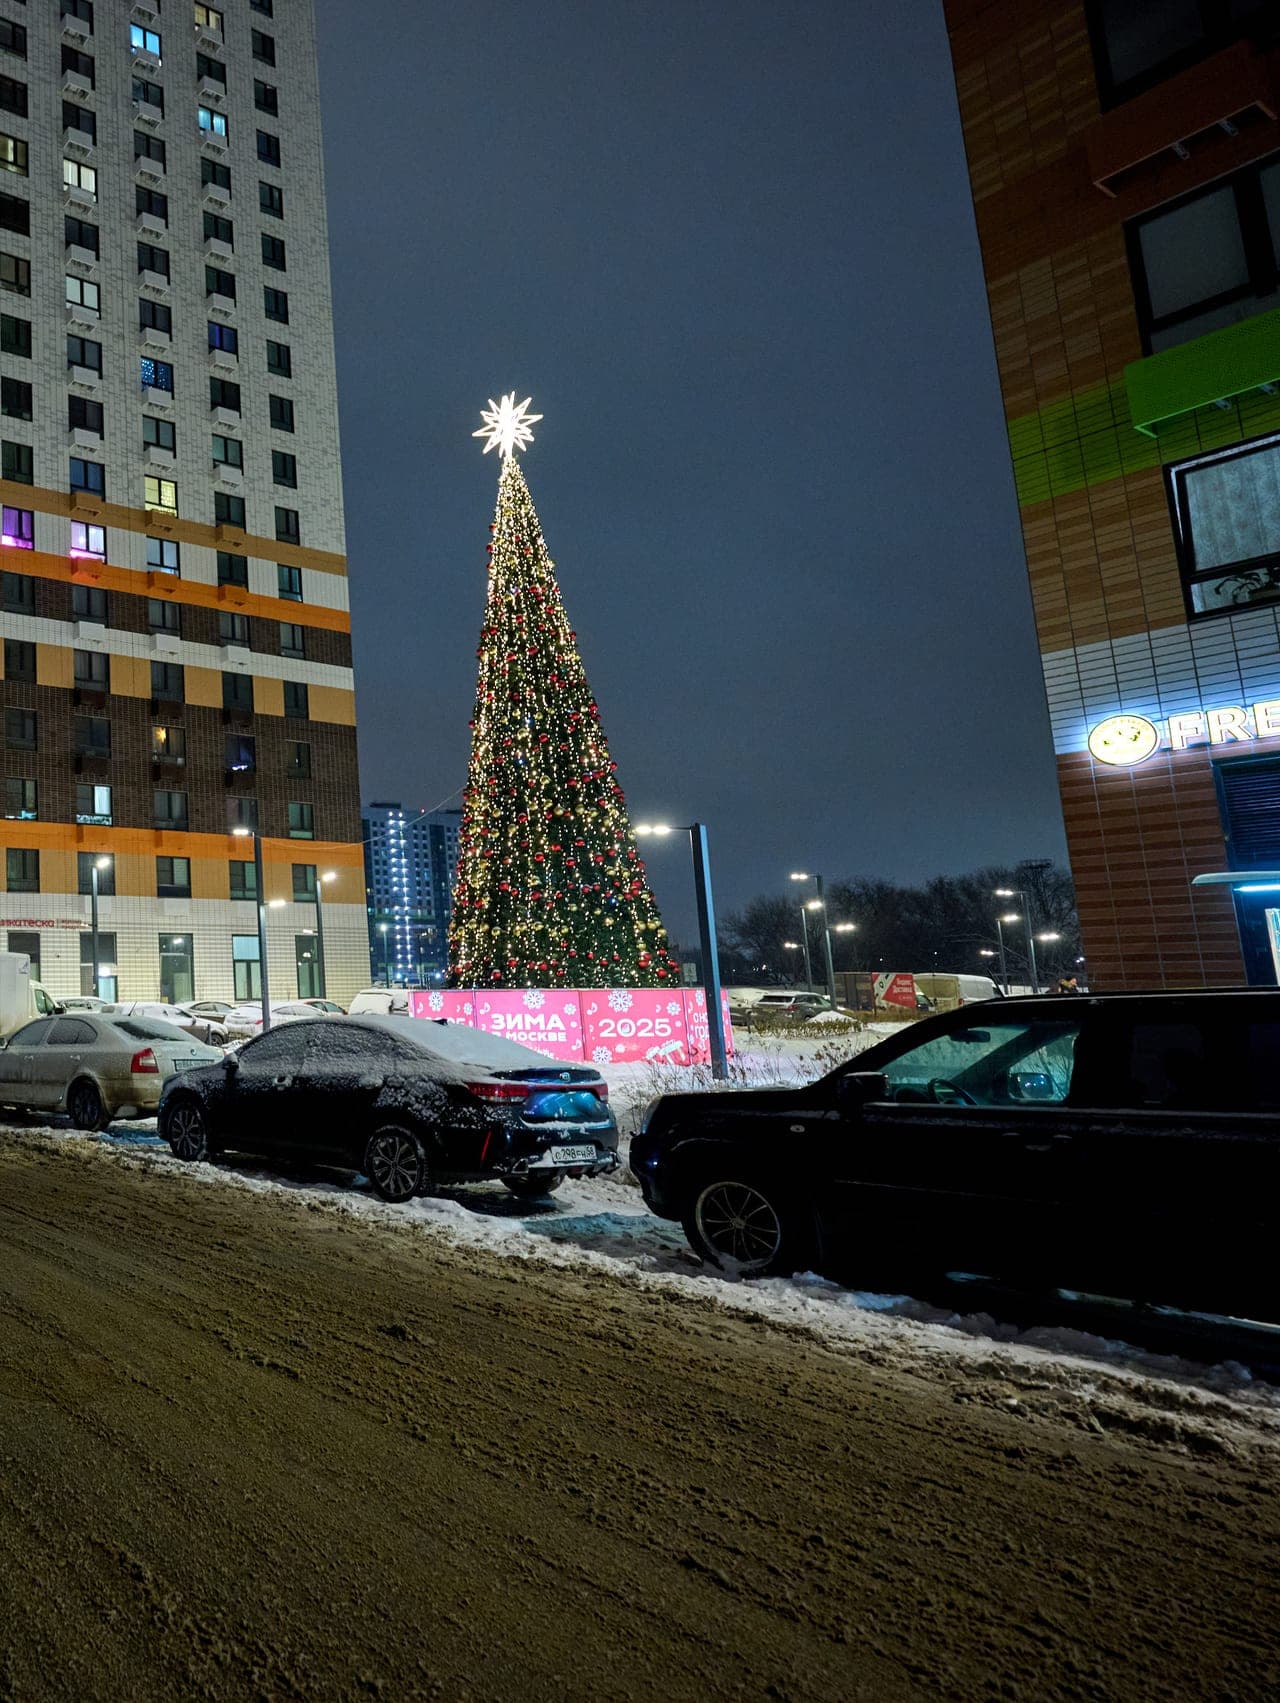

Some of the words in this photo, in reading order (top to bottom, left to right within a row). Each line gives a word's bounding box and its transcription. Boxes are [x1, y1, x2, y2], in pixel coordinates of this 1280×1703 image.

[491, 1013, 566, 1031] ЗИМА
[598, 1018, 672, 1037] 2025
[505, 1031, 567, 1042] МОСКВЕ
